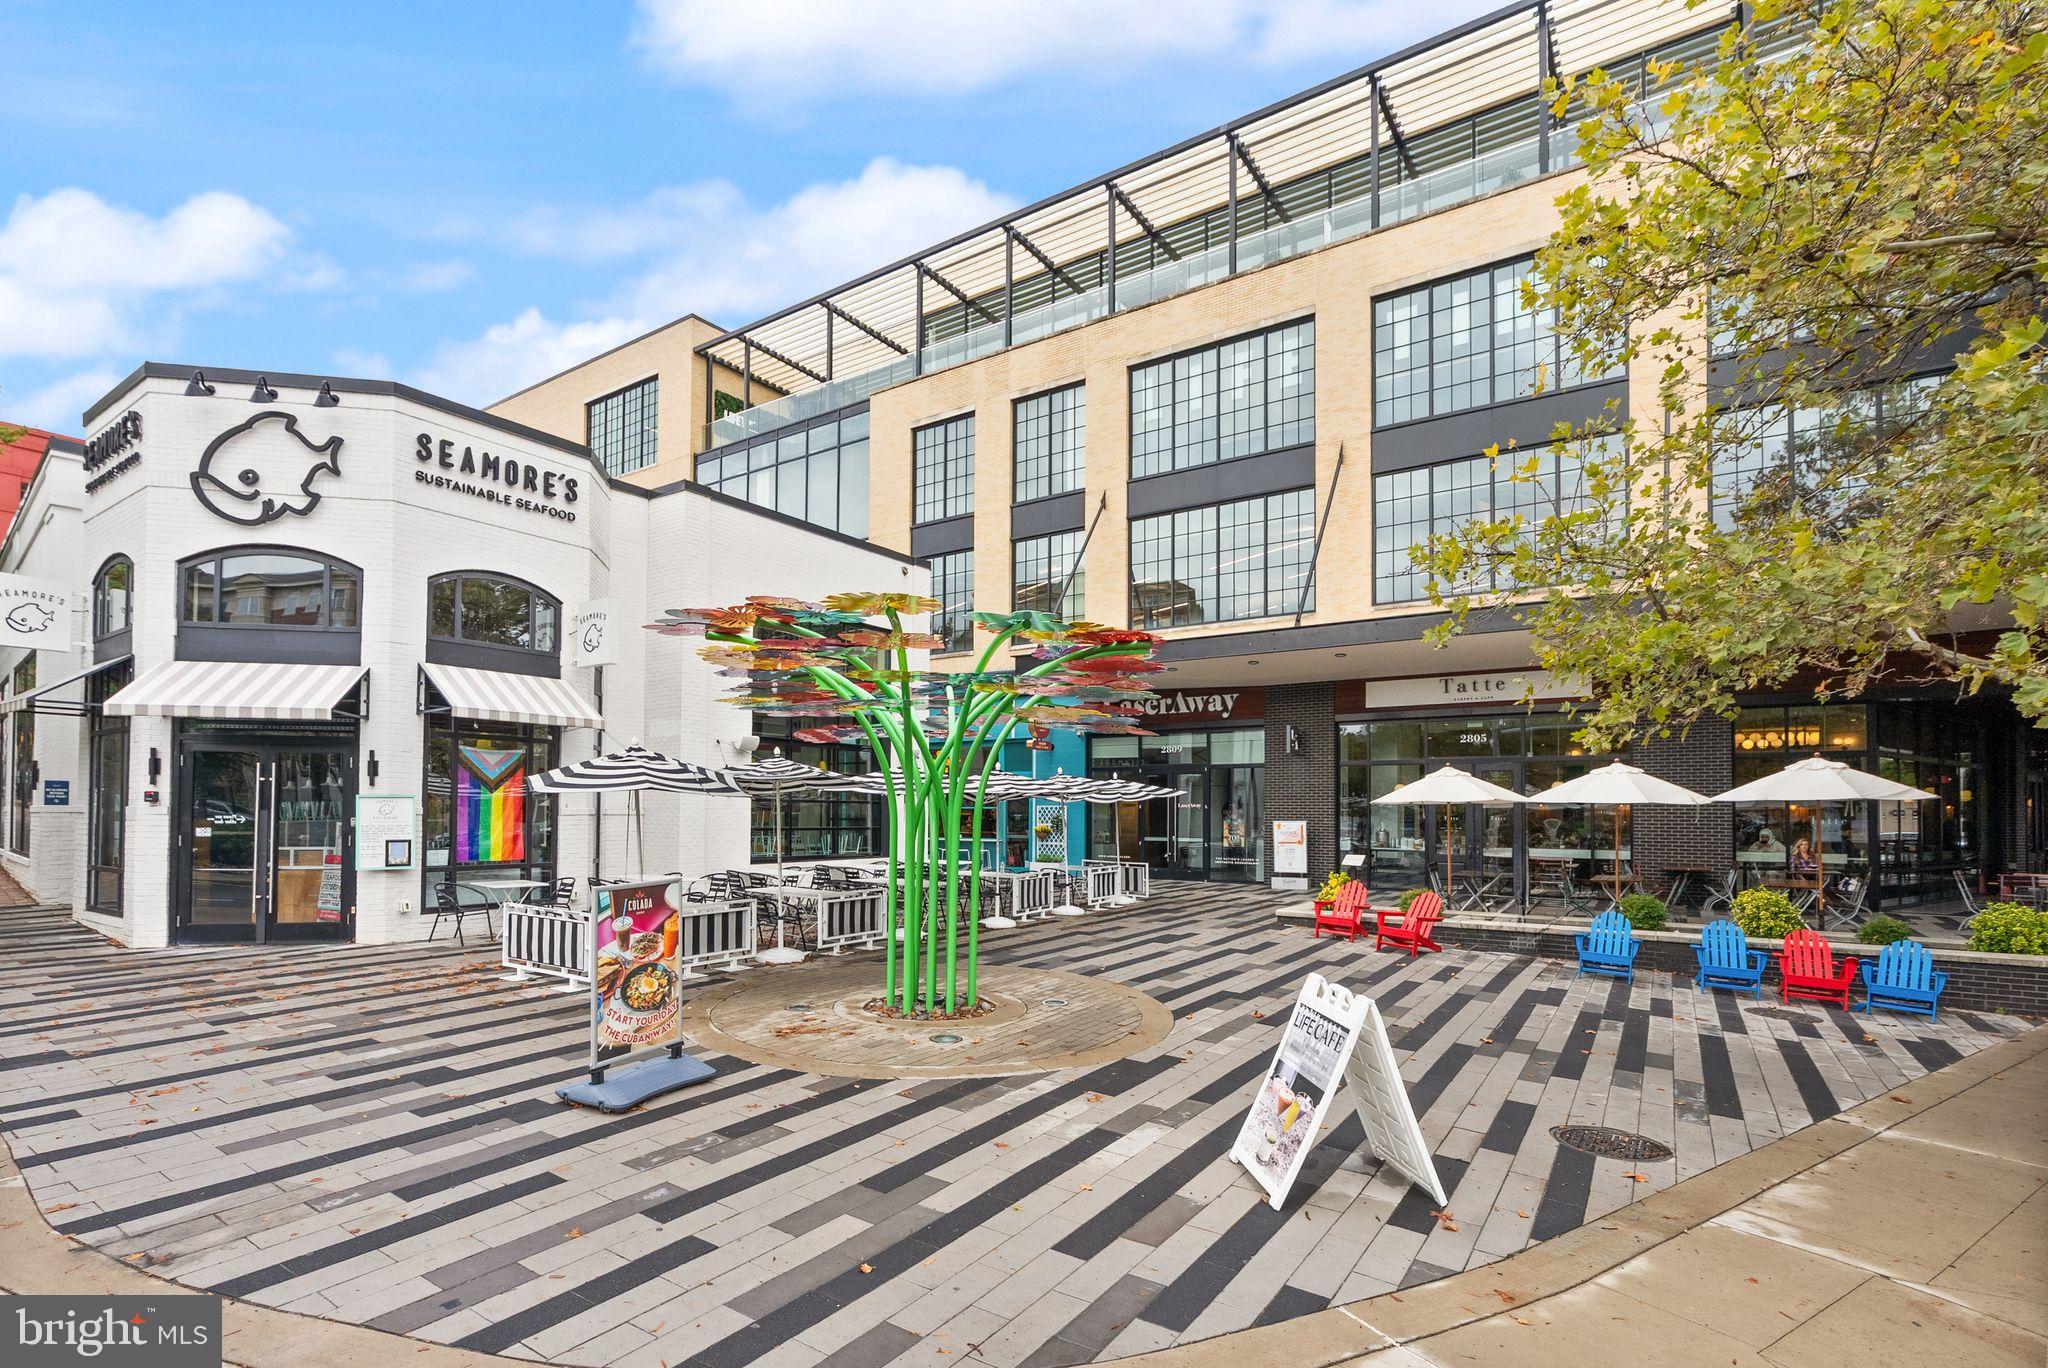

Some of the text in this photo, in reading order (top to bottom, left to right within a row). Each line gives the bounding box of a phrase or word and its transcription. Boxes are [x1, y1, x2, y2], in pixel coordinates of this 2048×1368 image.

[416, 433, 579, 503] SEAMORE'S
[415, 470, 576, 522] SUSTAINABLE SEAFOOD
[1439, 678, 1506, 694] Tatte
[1104, 691, 1239, 718] aserAway
[1160, 745, 1182, 754] 2809
[1460, 733, 1487, 743] 2805
[628, 898, 652, 911] COLADA
[606, 1001, 678, 1026] START YOUR DAY
[604, 1019, 675, 1043] THE CUBAN WAY!
[1293, 1011, 1346, 1054] LIFE CAFE
